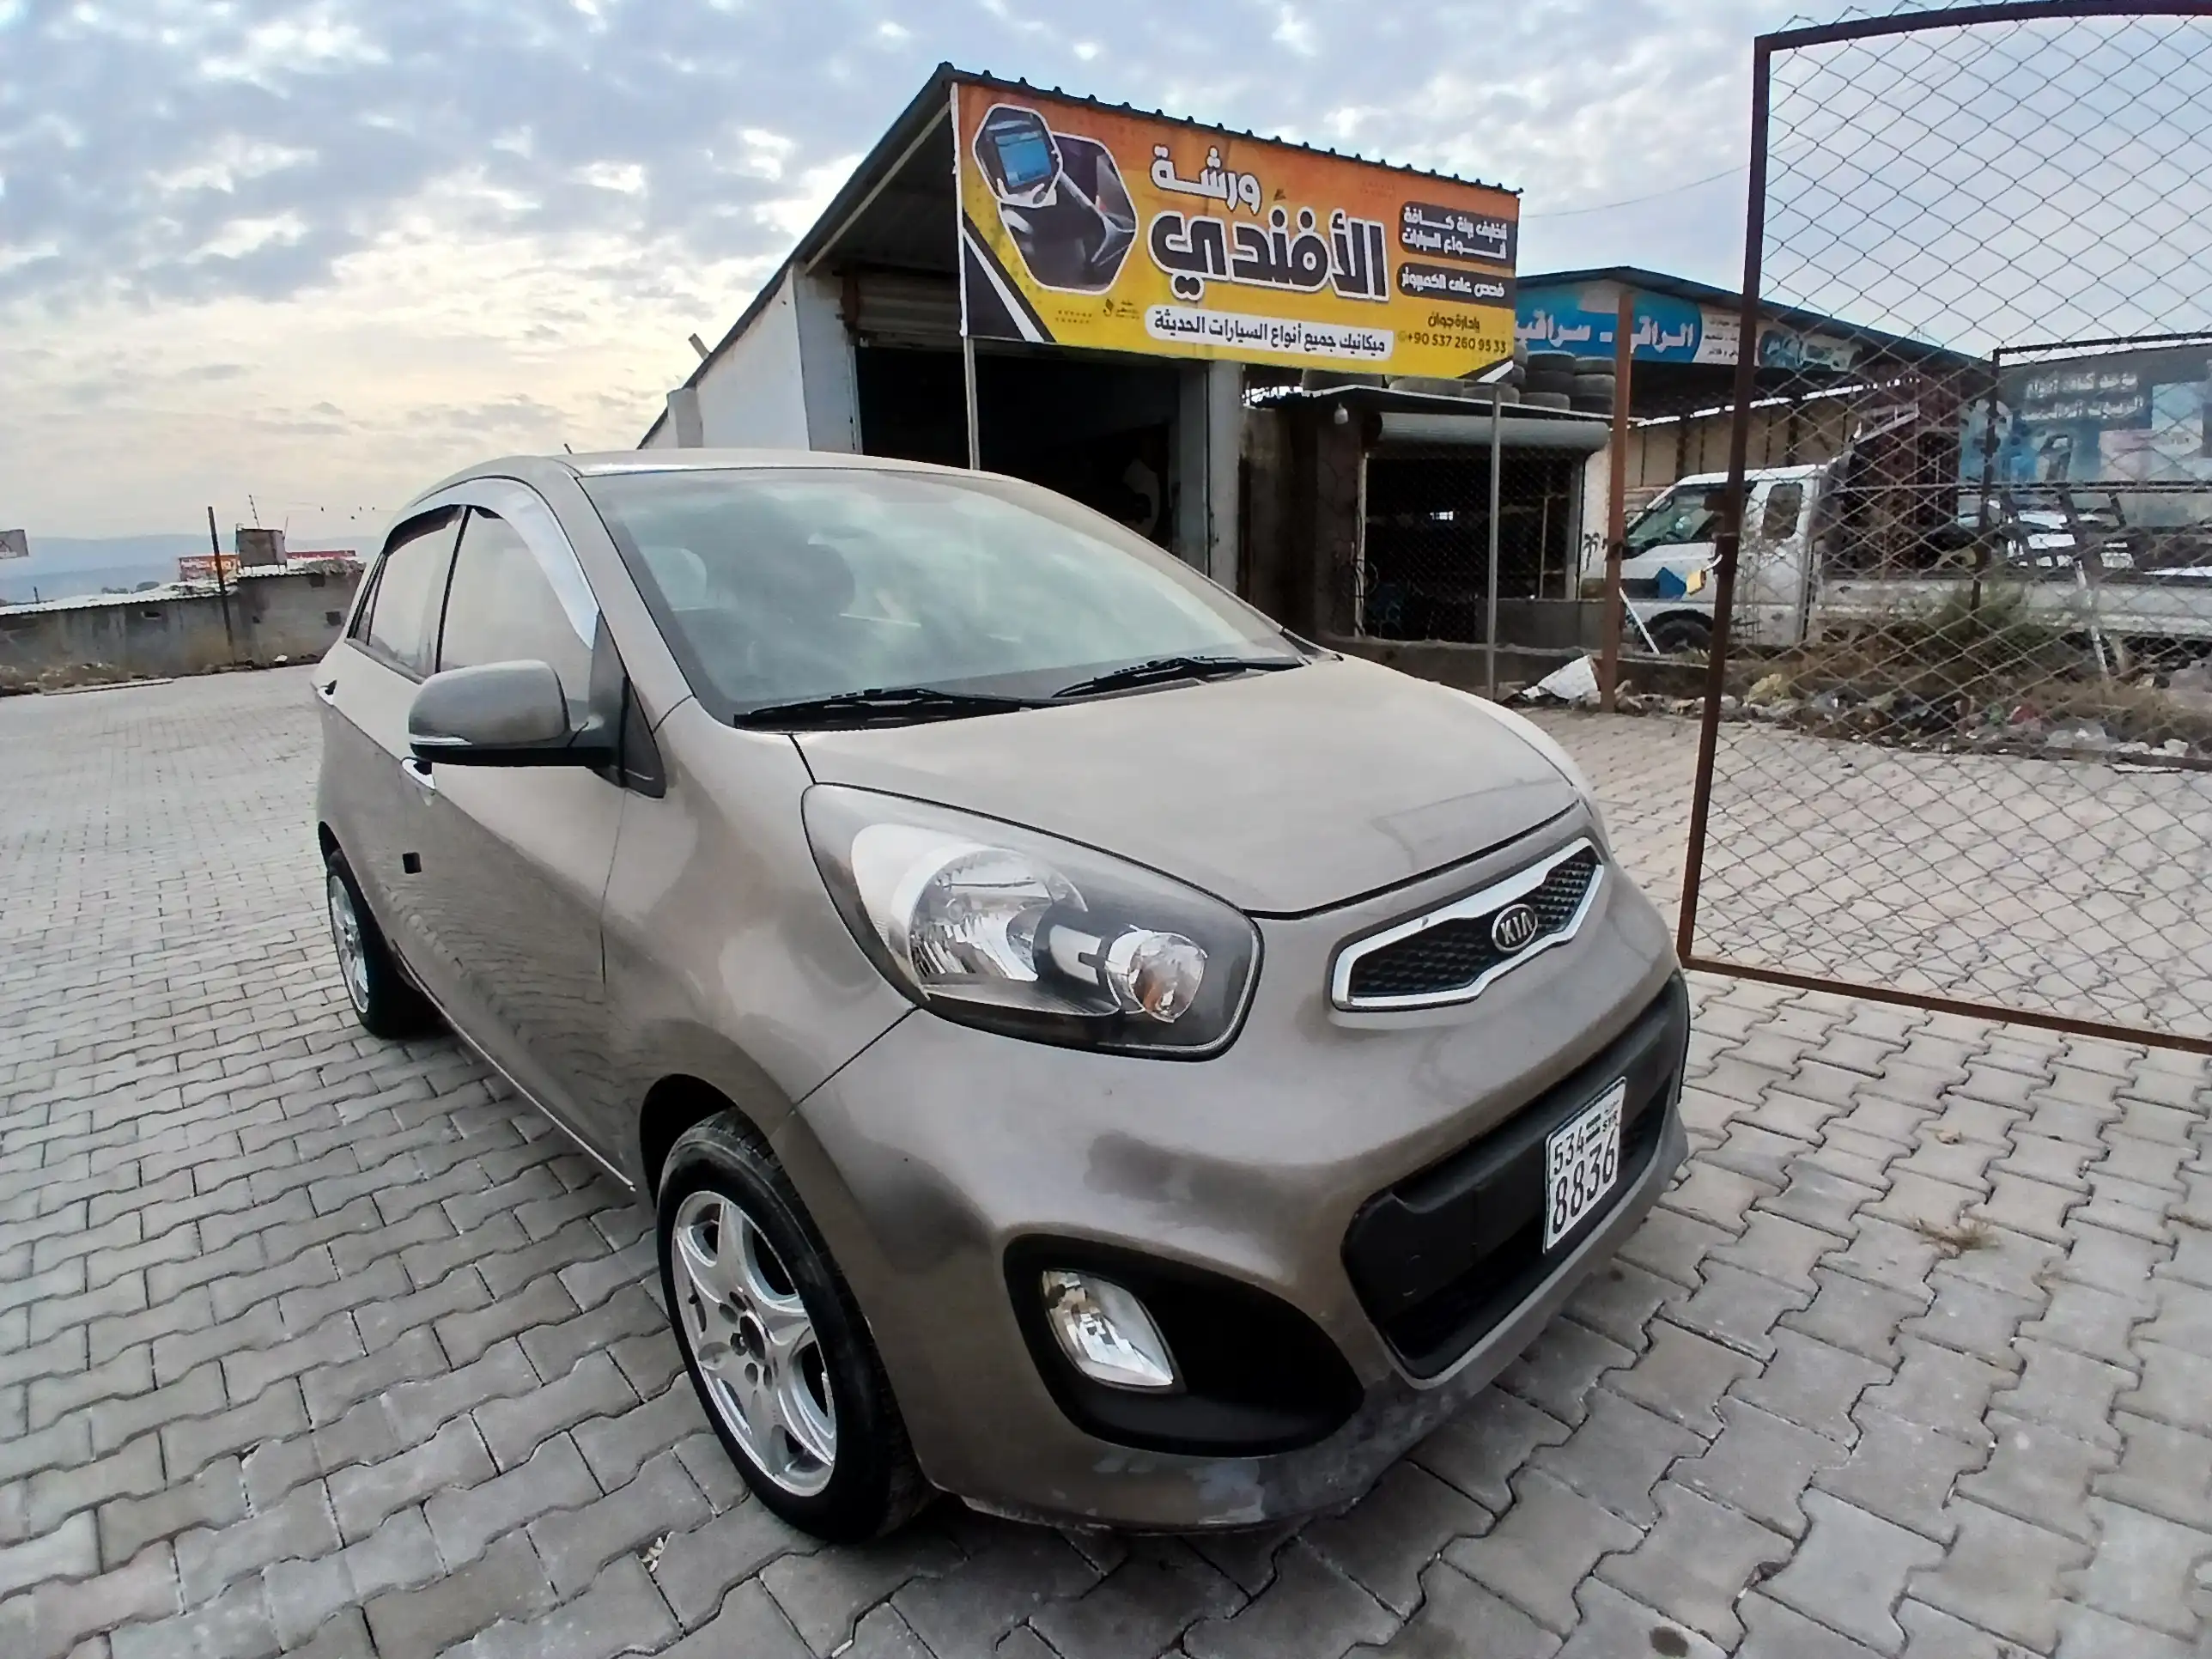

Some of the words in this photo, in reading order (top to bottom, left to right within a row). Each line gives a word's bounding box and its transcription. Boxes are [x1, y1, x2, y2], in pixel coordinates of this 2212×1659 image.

[1151, 144, 1262, 216] ورشة
[1402, 228, 1441, 251] السيارات
[1147, 205, 1389, 301] الأفندي
[1474, 283, 1504, 297] فحص
[1154, 309, 1206, 337] الحديثة
[1209, 317, 1268, 342] السيارات
[1271, 323, 1302, 348] أنواع
[1630, 316, 1693, 354] الراق
[1303, 332, 1336, 352] جميع
[1339, 331, 1385, 356] ميكانيك
[1408, 331, 1430, 345] +90
[1431, 333, 1452, 347] 537
[1455, 336, 1476, 350] 260
[1478, 338, 1492, 352] 95
[1493, 339, 1506, 353] 33
[1500, 911, 1533, 945] KIA
[1553, 1126, 1584, 1176] 534
[1553, 1127, 1615, 1234] 8836
